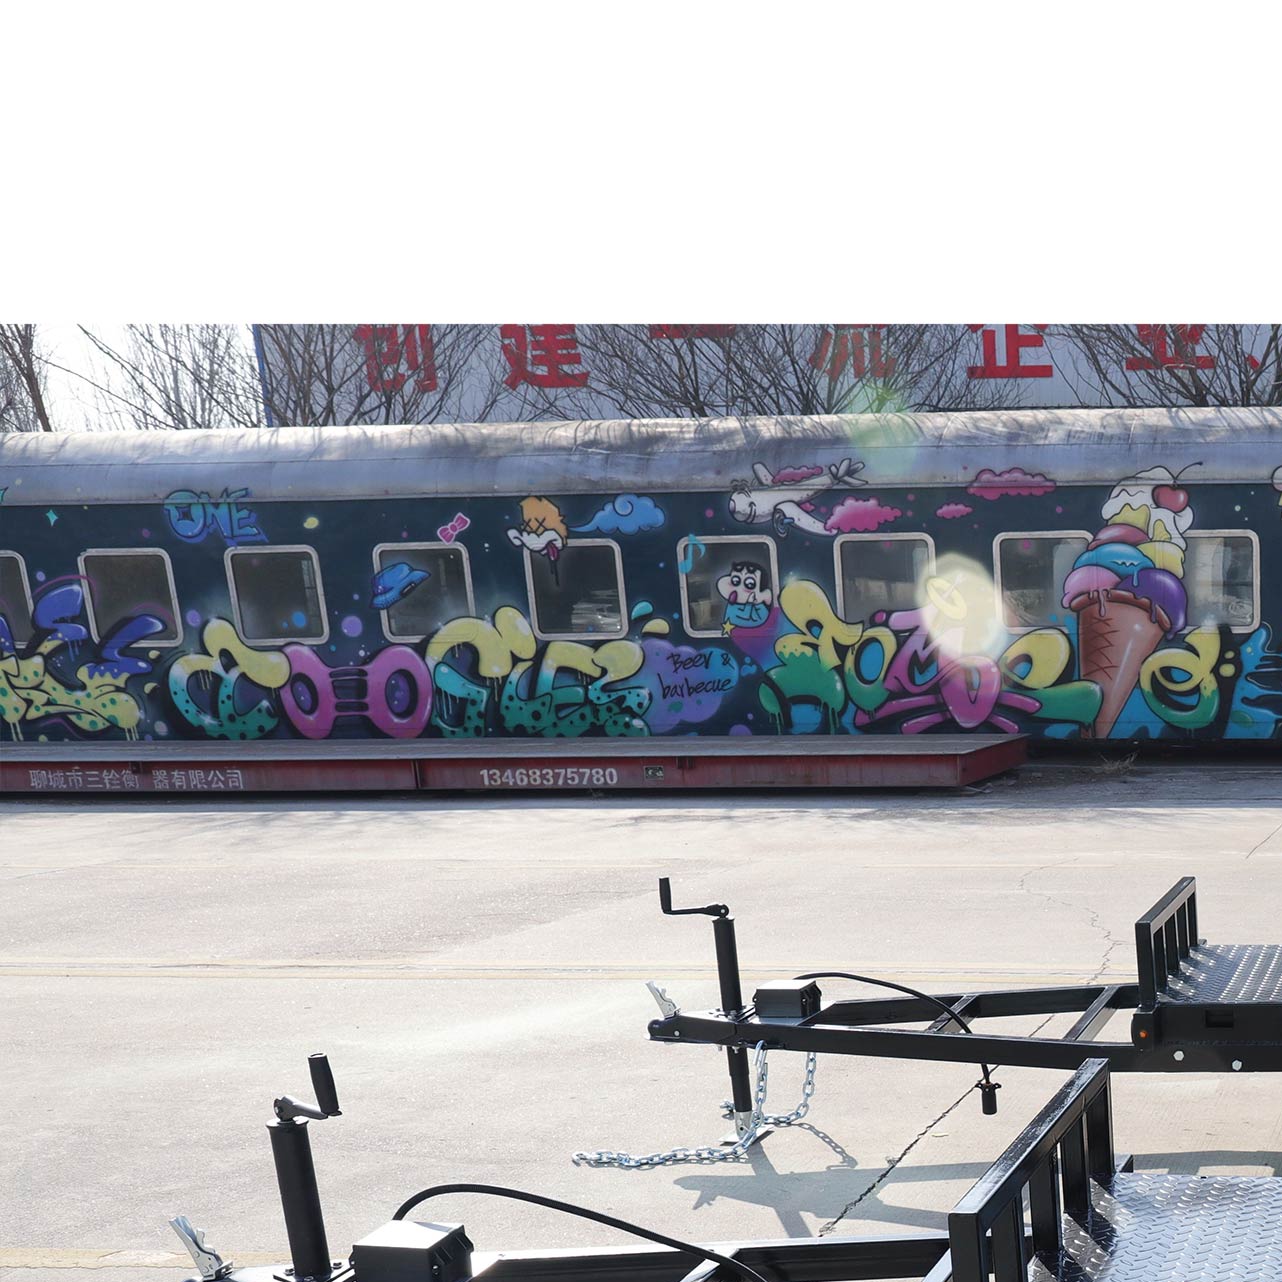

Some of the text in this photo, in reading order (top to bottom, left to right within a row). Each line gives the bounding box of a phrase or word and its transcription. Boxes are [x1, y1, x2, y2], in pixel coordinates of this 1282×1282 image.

[667, 651, 735, 674] Beer &
[657, 673, 732, 699] barbecue
[480, 768, 618, 786] 13468375780
